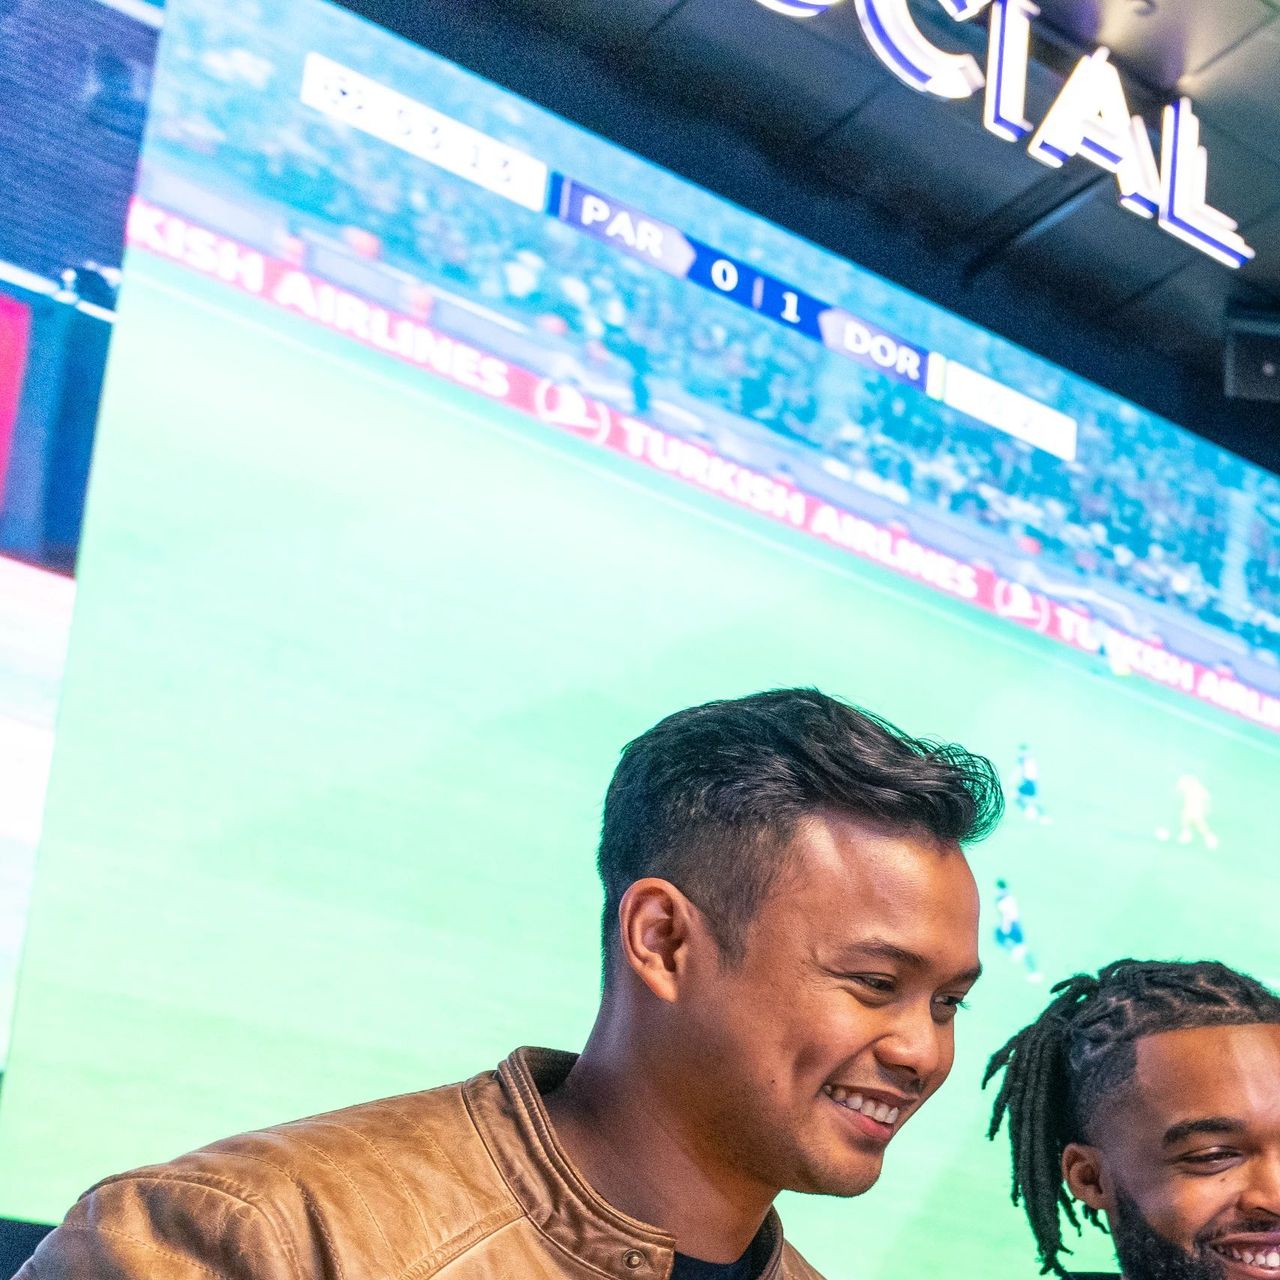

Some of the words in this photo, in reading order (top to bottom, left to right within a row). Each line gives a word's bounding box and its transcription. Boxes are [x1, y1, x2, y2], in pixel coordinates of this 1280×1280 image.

[747, 0, 1254, 270] CIAL
[272, 270, 509, 398] AIRLINES
[580, 194, 663, 257] PAR
[711, 259, 738, 292] 0
[780, 291, 800, 323] 1
[843, 320, 920, 380] DOR
[619, 416, 806, 527] TURKISH
[810, 504, 979, 599] AIRLINES
